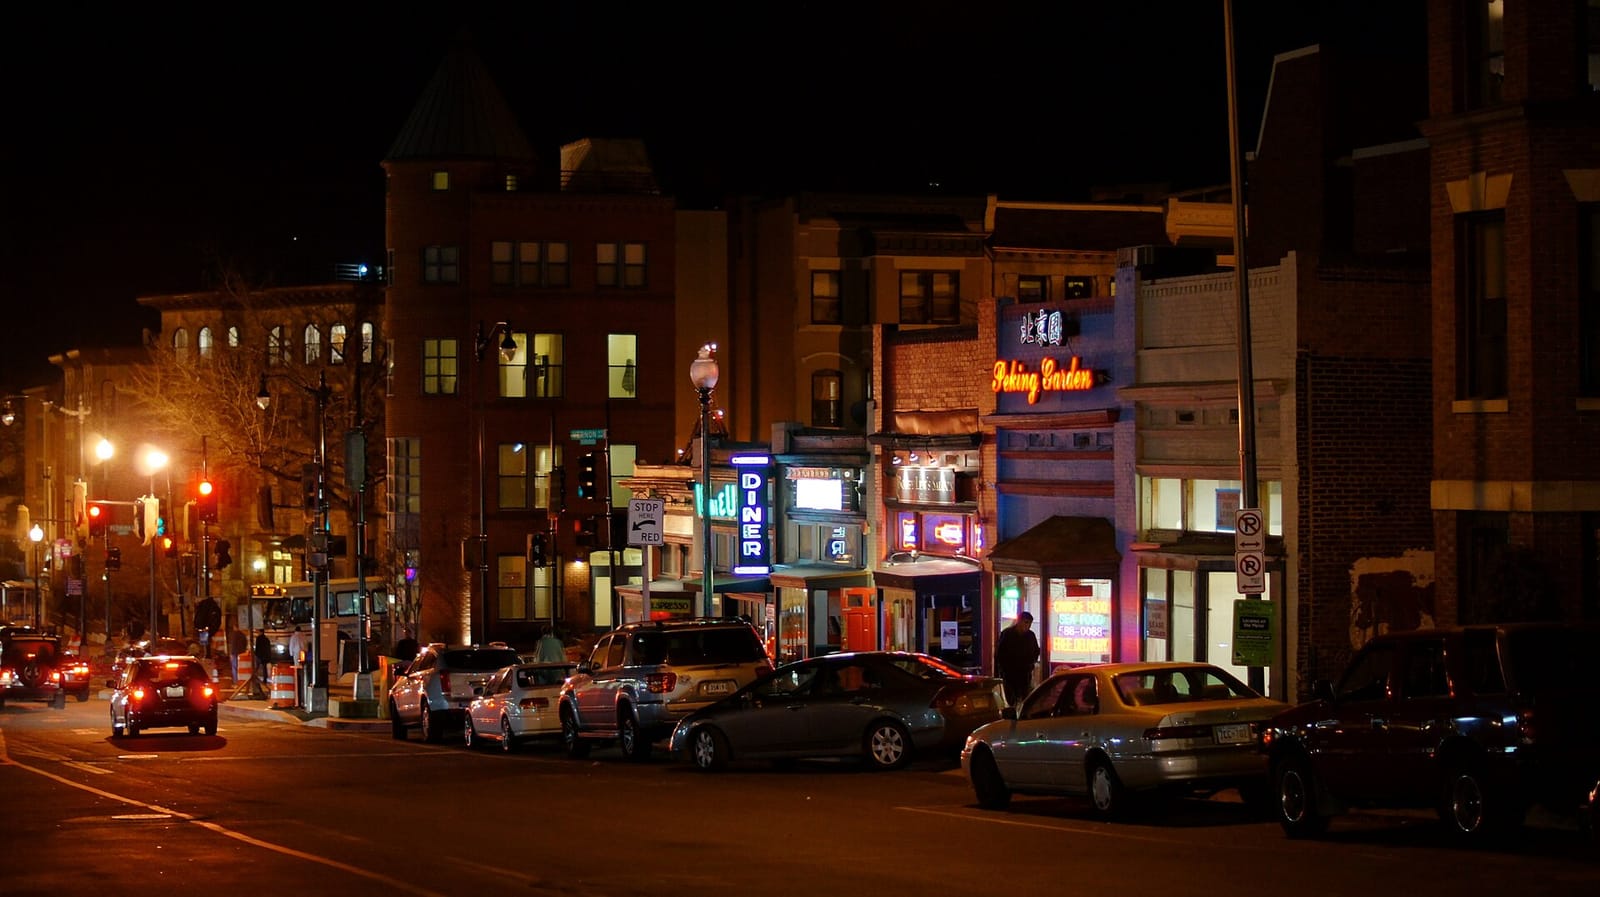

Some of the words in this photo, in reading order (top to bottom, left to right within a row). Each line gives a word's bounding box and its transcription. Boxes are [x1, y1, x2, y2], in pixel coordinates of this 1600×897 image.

[992, 360, 1040, 404] Peking
[1041, 357, 1092, 390] Garden
[635, 502, 659, 512] STOP
[741, 473, 762, 557] DINER
[641, 533, 660, 542] RED
